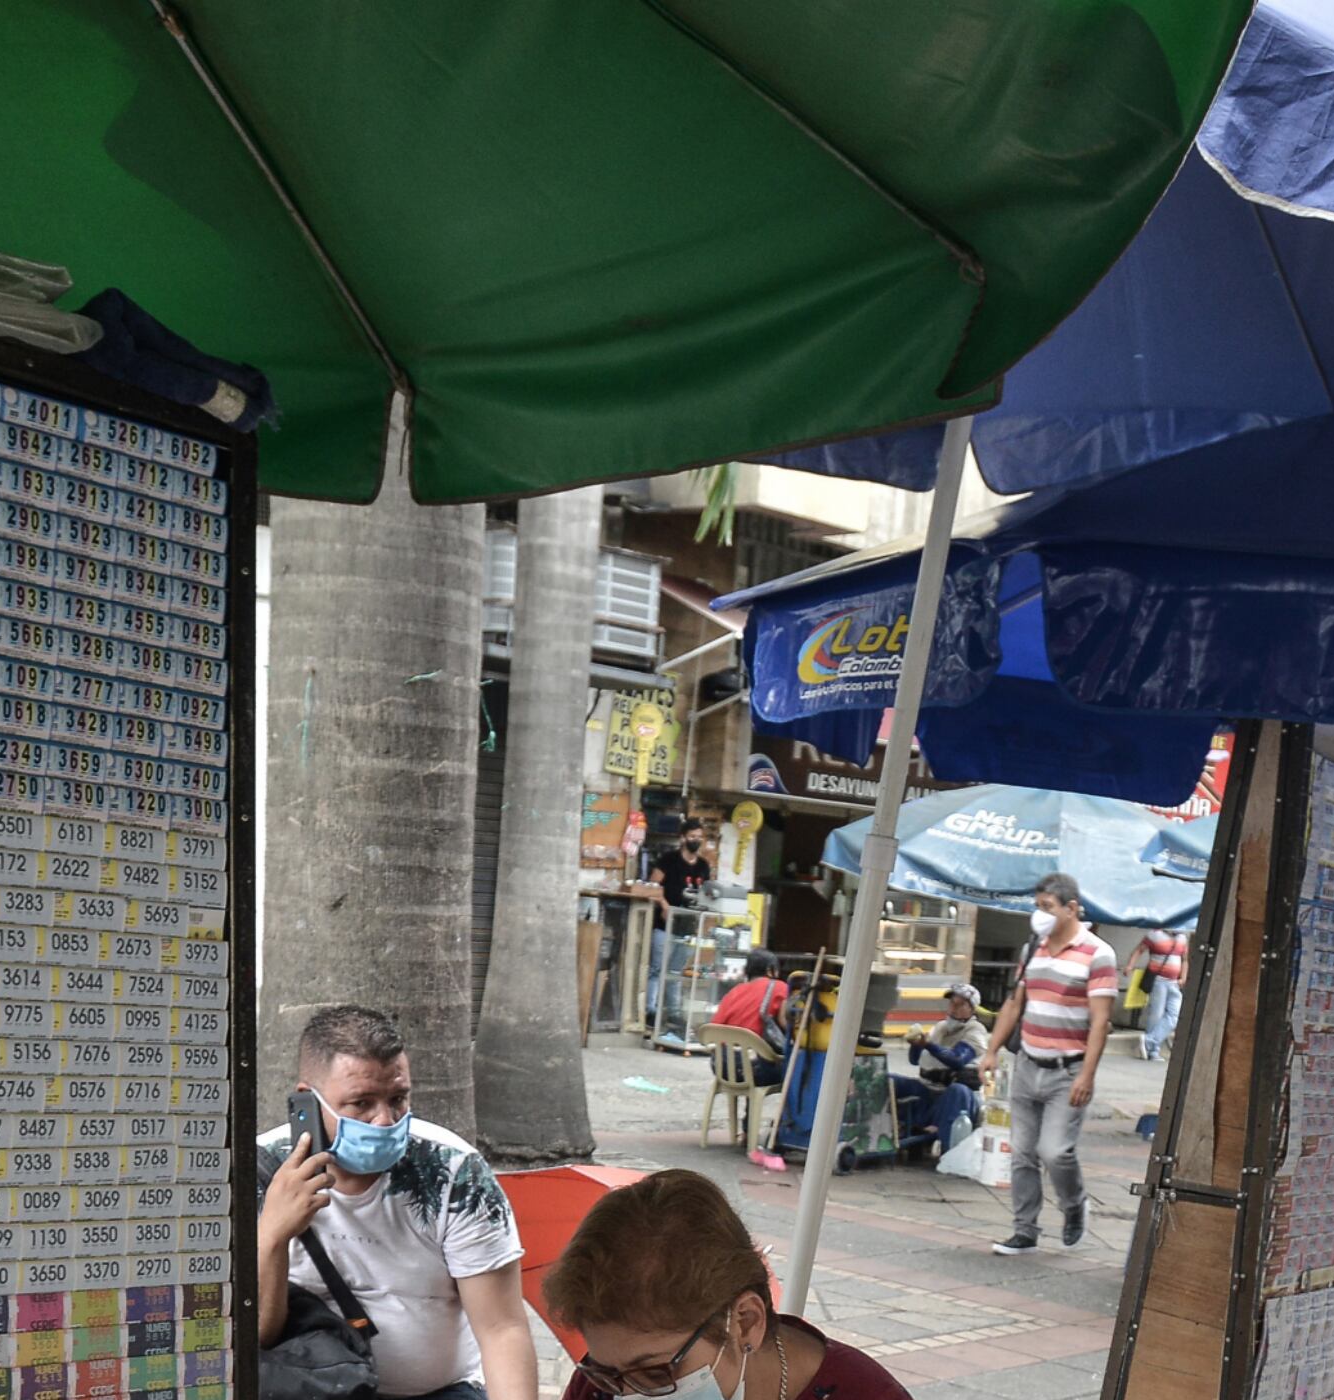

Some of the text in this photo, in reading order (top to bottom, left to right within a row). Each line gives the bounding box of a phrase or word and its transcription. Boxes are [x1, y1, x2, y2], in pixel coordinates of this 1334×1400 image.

[107, 420, 149, 447] 5261
[171, 437, 211, 465] 6052
[183, 511, 222, 538] 8913
[831, 615, 911, 654] Lot
[838, 656, 905, 677] Colomb
[182, 765, 220, 791] 5400
[974, 809, 1017, 826] Net
[944, 812, 1046, 848] Group
[183, 837, 215, 857] 3791
[184, 1013, 219, 1031] 4125
[186, 1083, 220, 1100] 7726
[14, 1153, 52, 1171] 9338
[188, 1255, 222, 1274] 8280
